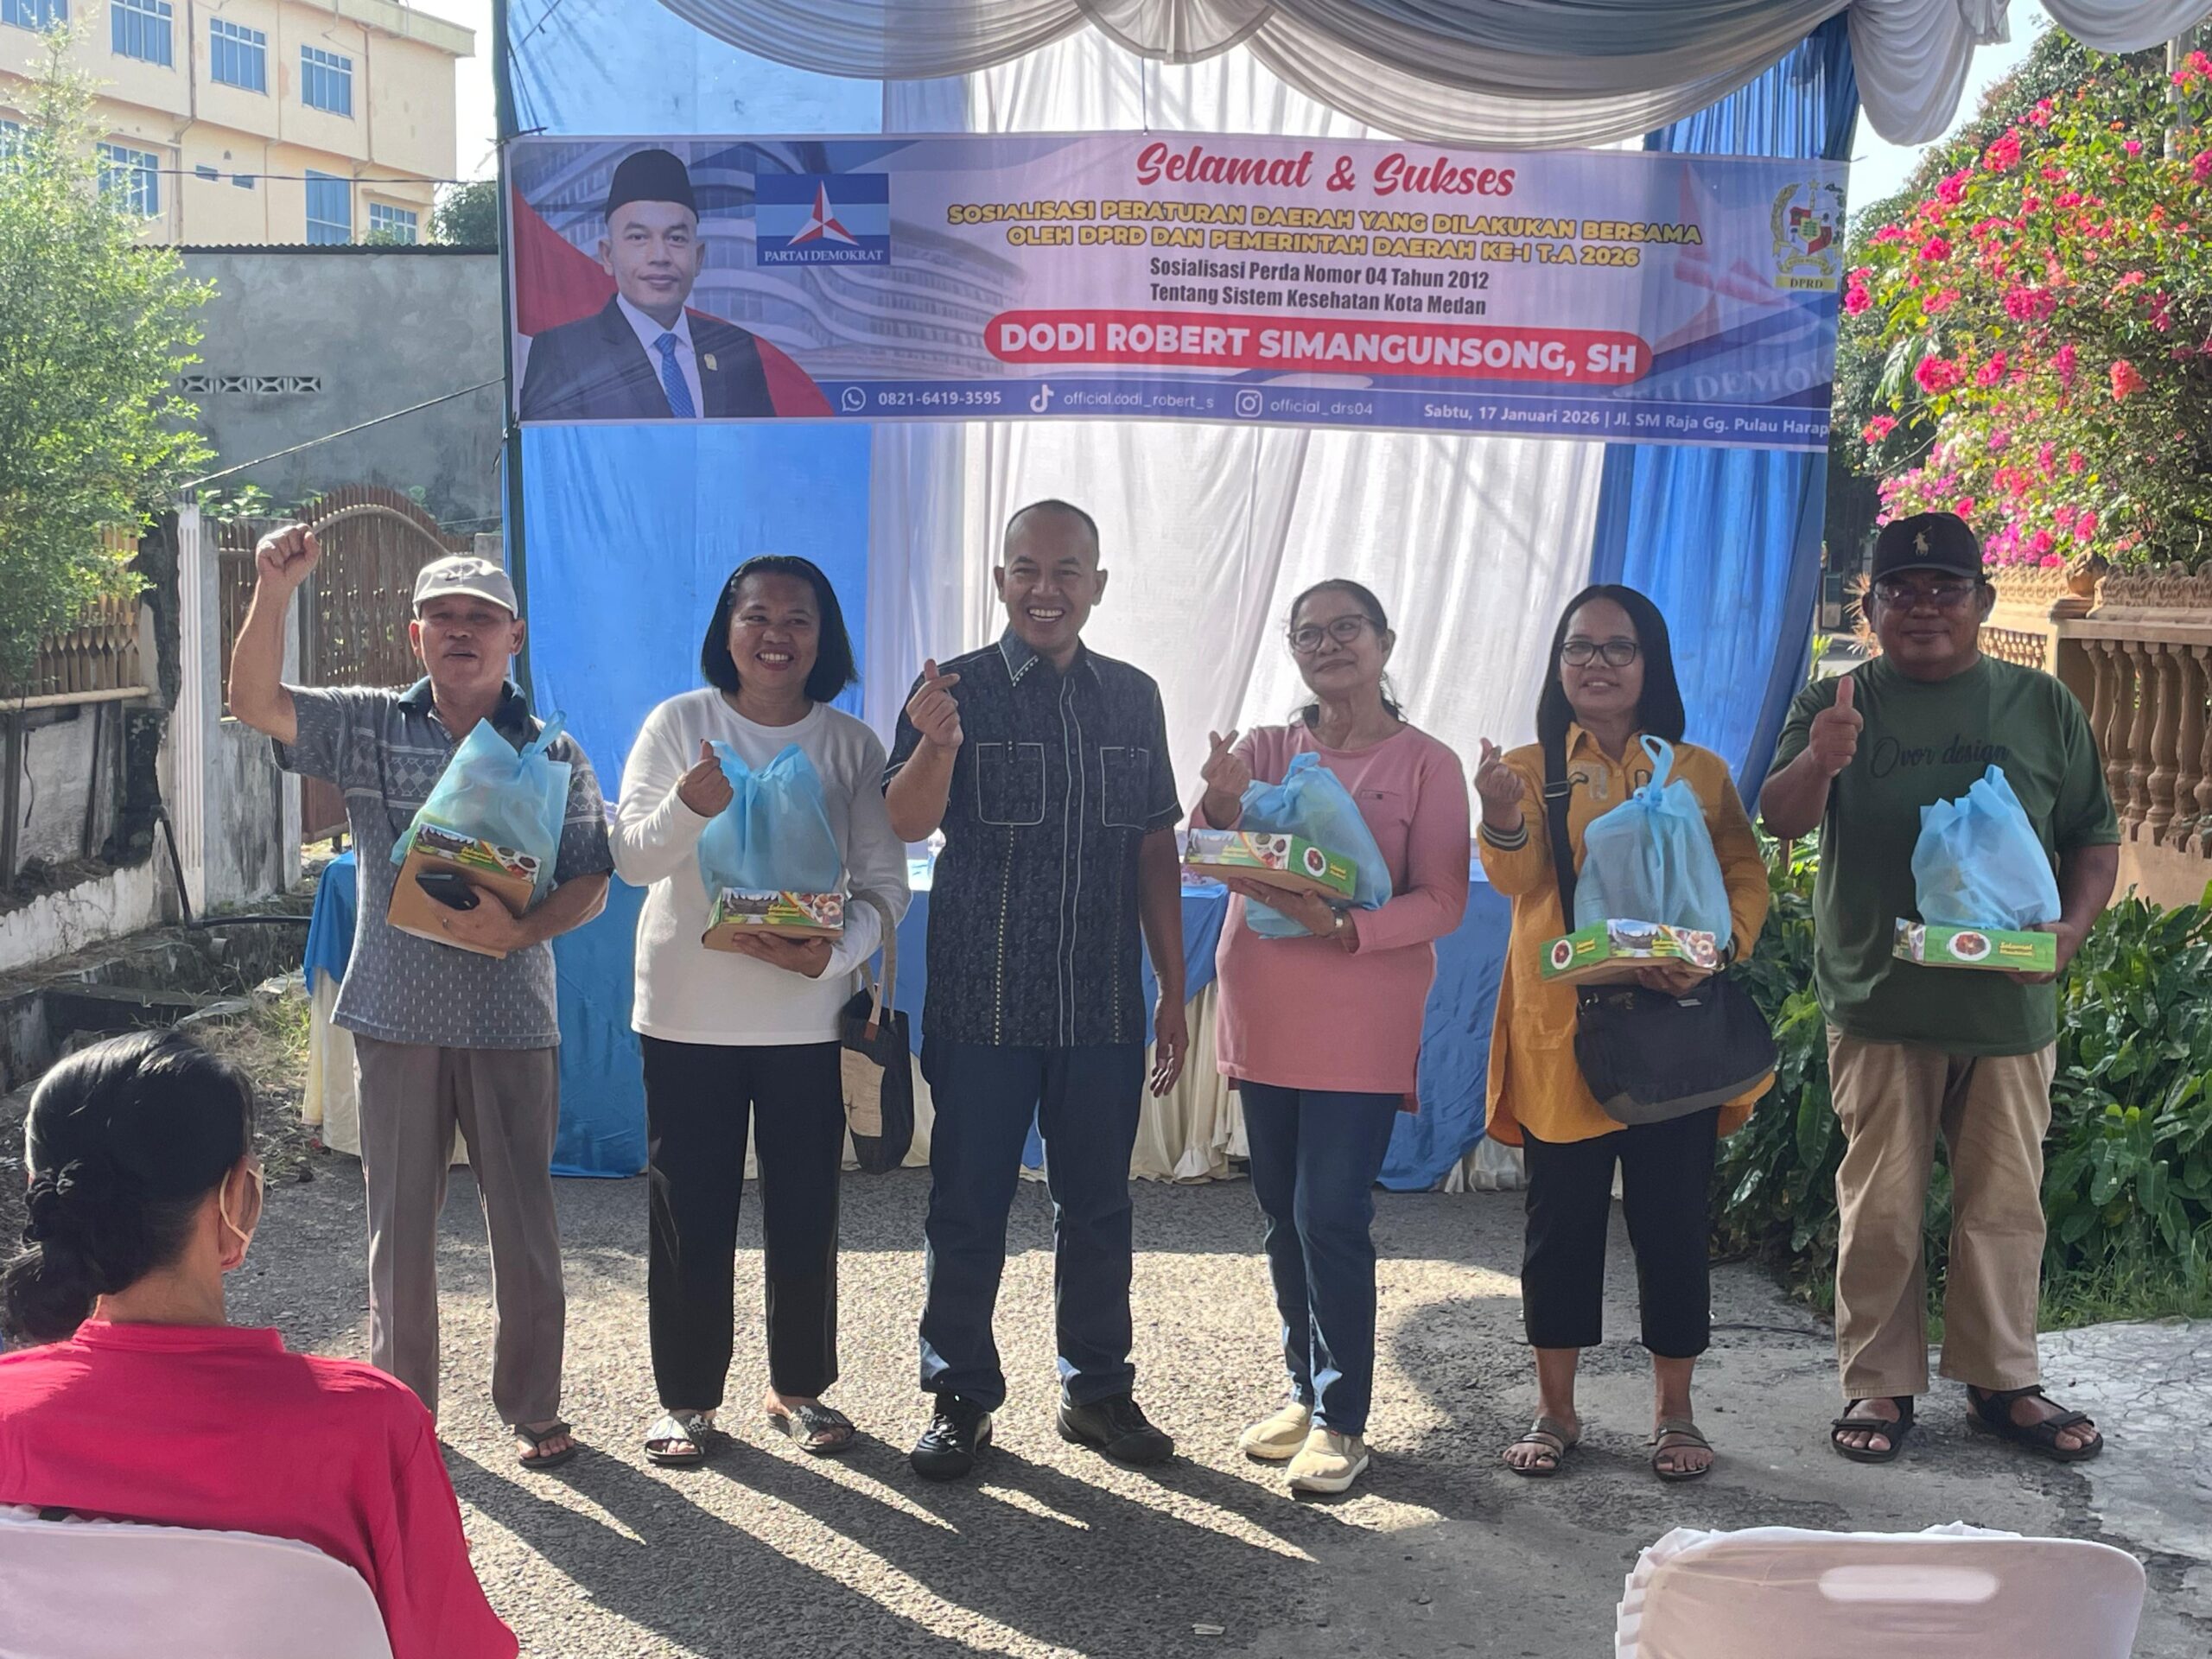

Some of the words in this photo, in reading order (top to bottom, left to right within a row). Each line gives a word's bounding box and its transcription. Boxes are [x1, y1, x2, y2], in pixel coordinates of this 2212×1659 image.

[1136, 142, 1313, 187] Selamat
[1326, 156, 1356, 192] &
[1373, 153, 1516, 196] Sukses
[948, 200, 1095, 225] SOSIALISASI
[1101, 200, 1246, 226] PERATURAN
[1251, 207, 1354, 230] DAERAH
[1359, 211, 1427, 233] YANG
[1433, 213, 1576, 239] DILAKUKAN
[1582, 220, 1702, 245] BERSAMA
[765, 251, 808, 262] PARTAI
[810, 250, 884, 262] DEMOKRAT
[1007, 226, 1073, 246] OLEH
[1078, 226, 1147, 246] DPRD
[1151, 226, 1205, 248] DAN
[1210, 231, 1368, 255] PEMERINTAH
[1373, 236, 1476, 259] DAERAH
[1481, 241, 1531, 263] KE-I
[1536, 245, 1577, 264] T.A
[1580, 245, 1640, 267] 2026
[1150, 257, 1245, 279] Sosialisasi
[1249, 261, 1300, 281] Perda
[1304, 264, 1362, 283] Nomor
[1365, 267, 1387, 285] 04
[1391, 268, 1444, 288] Tahun
[1447, 270, 1490, 289] 2012
[1790, 277, 1824, 289] DPRD
[1150, 283, 1218, 305] Tentang
[1222, 286, 1282, 307] Sistem
[1287, 289, 1380, 311] Kesehatan
[1383, 293, 1423, 313] Kota
[1427, 296, 1486, 315] Medan
[1001, 322, 1096, 353] DODI
[1107, 323, 1249, 356] ROBERT
[1258, 328, 1576, 377] SIMANGUNSONG,
[1586, 343, 1637, 373] SH
[878, 391, 1001, 406] 0821-6419-3595
[1270, 398, 1373, 416] official_drs04
[1424, 404, 1472, 421] Sabtu,
[1478, 406, 1497, 420] 17
[1501, 407, 1558, 423] Januari
[1561, 410, 1599, 424] 2026
[1614, 412, 1631, 426] Jl.
[1636, 413, 1660, 427] SM
[1666, 415, 1698, 432] Raja
[1703, 416, 1729, 433] Gg.
[1734, 417, 1777, 432] Pulau
[1783, 420, 1829, 437] Harap
